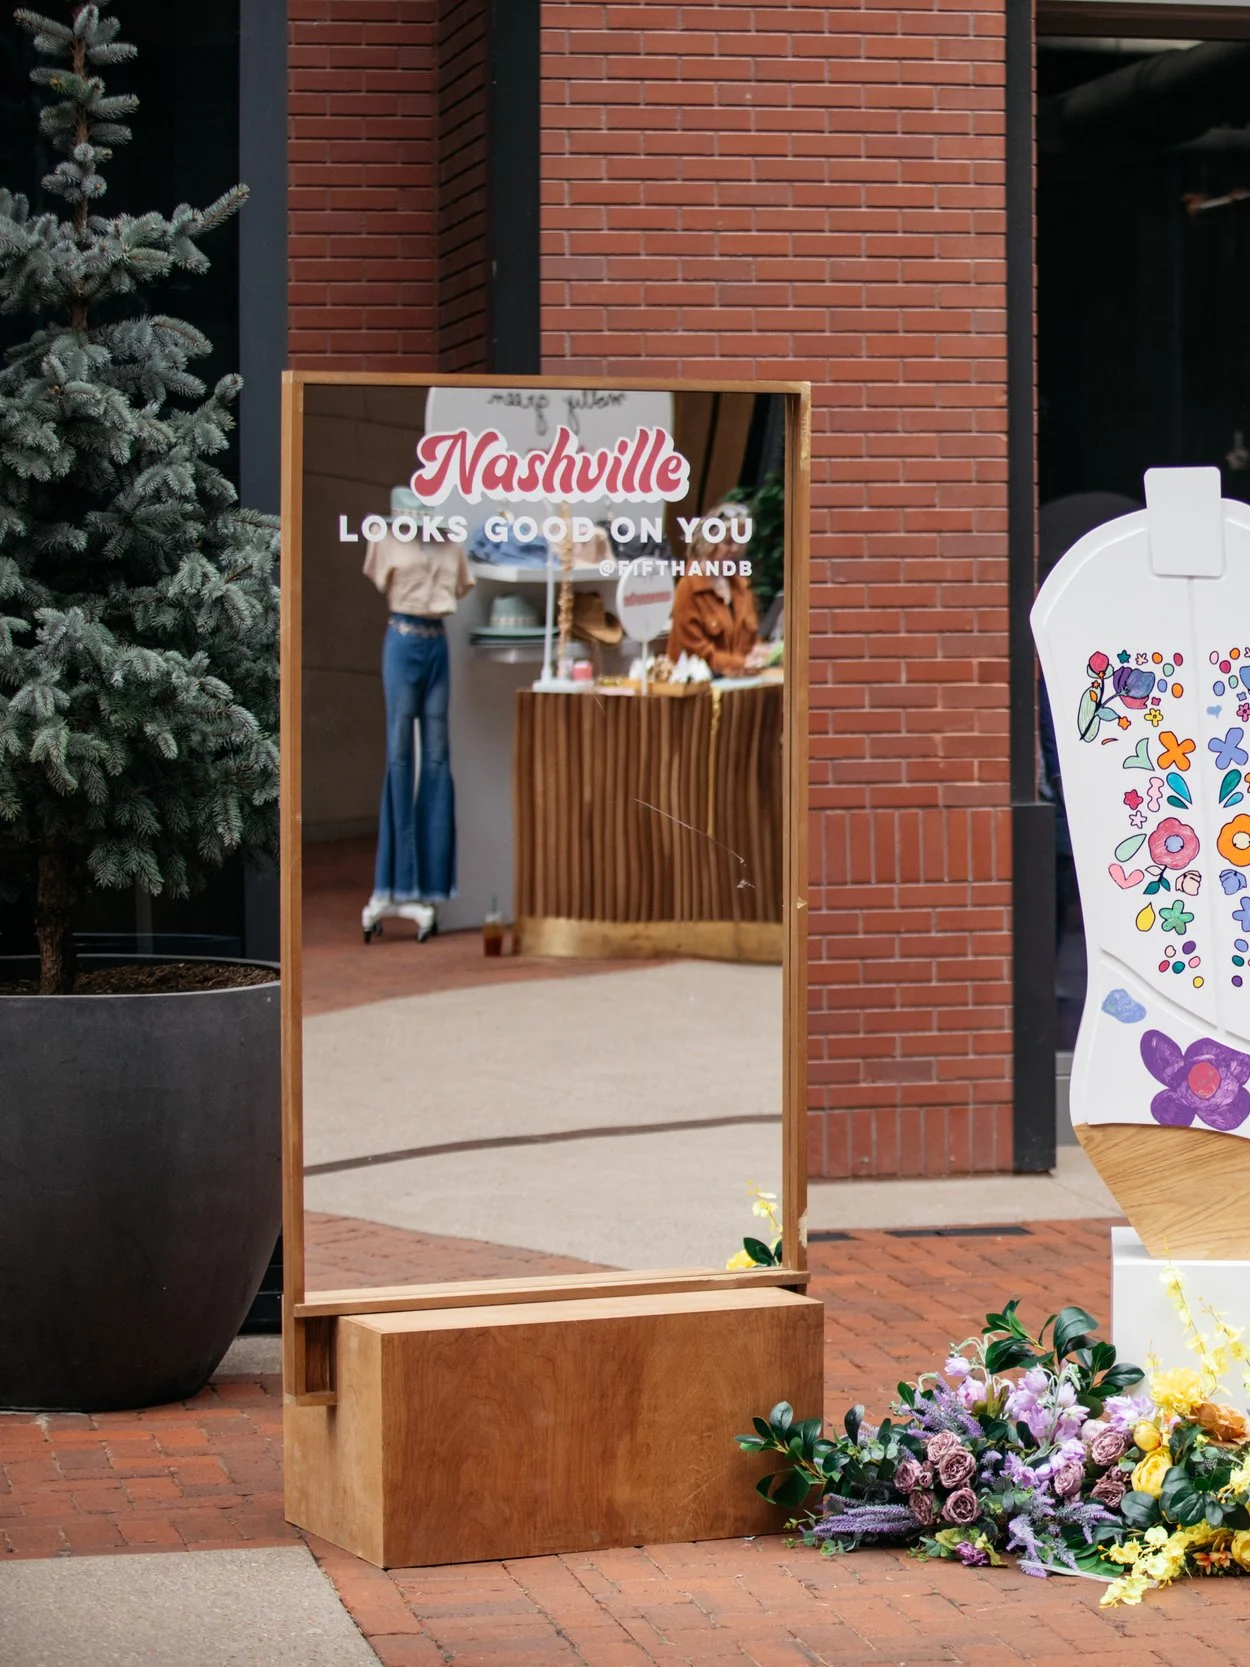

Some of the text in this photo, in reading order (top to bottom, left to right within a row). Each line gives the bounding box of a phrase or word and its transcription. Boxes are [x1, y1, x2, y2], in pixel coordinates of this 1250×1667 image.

[411, 425, 689, 503] Nashville
[338, 514, 754, 545] LOOKS GOOD ON YOU
[598, 560, 753, 578] @FIFTHANDB
